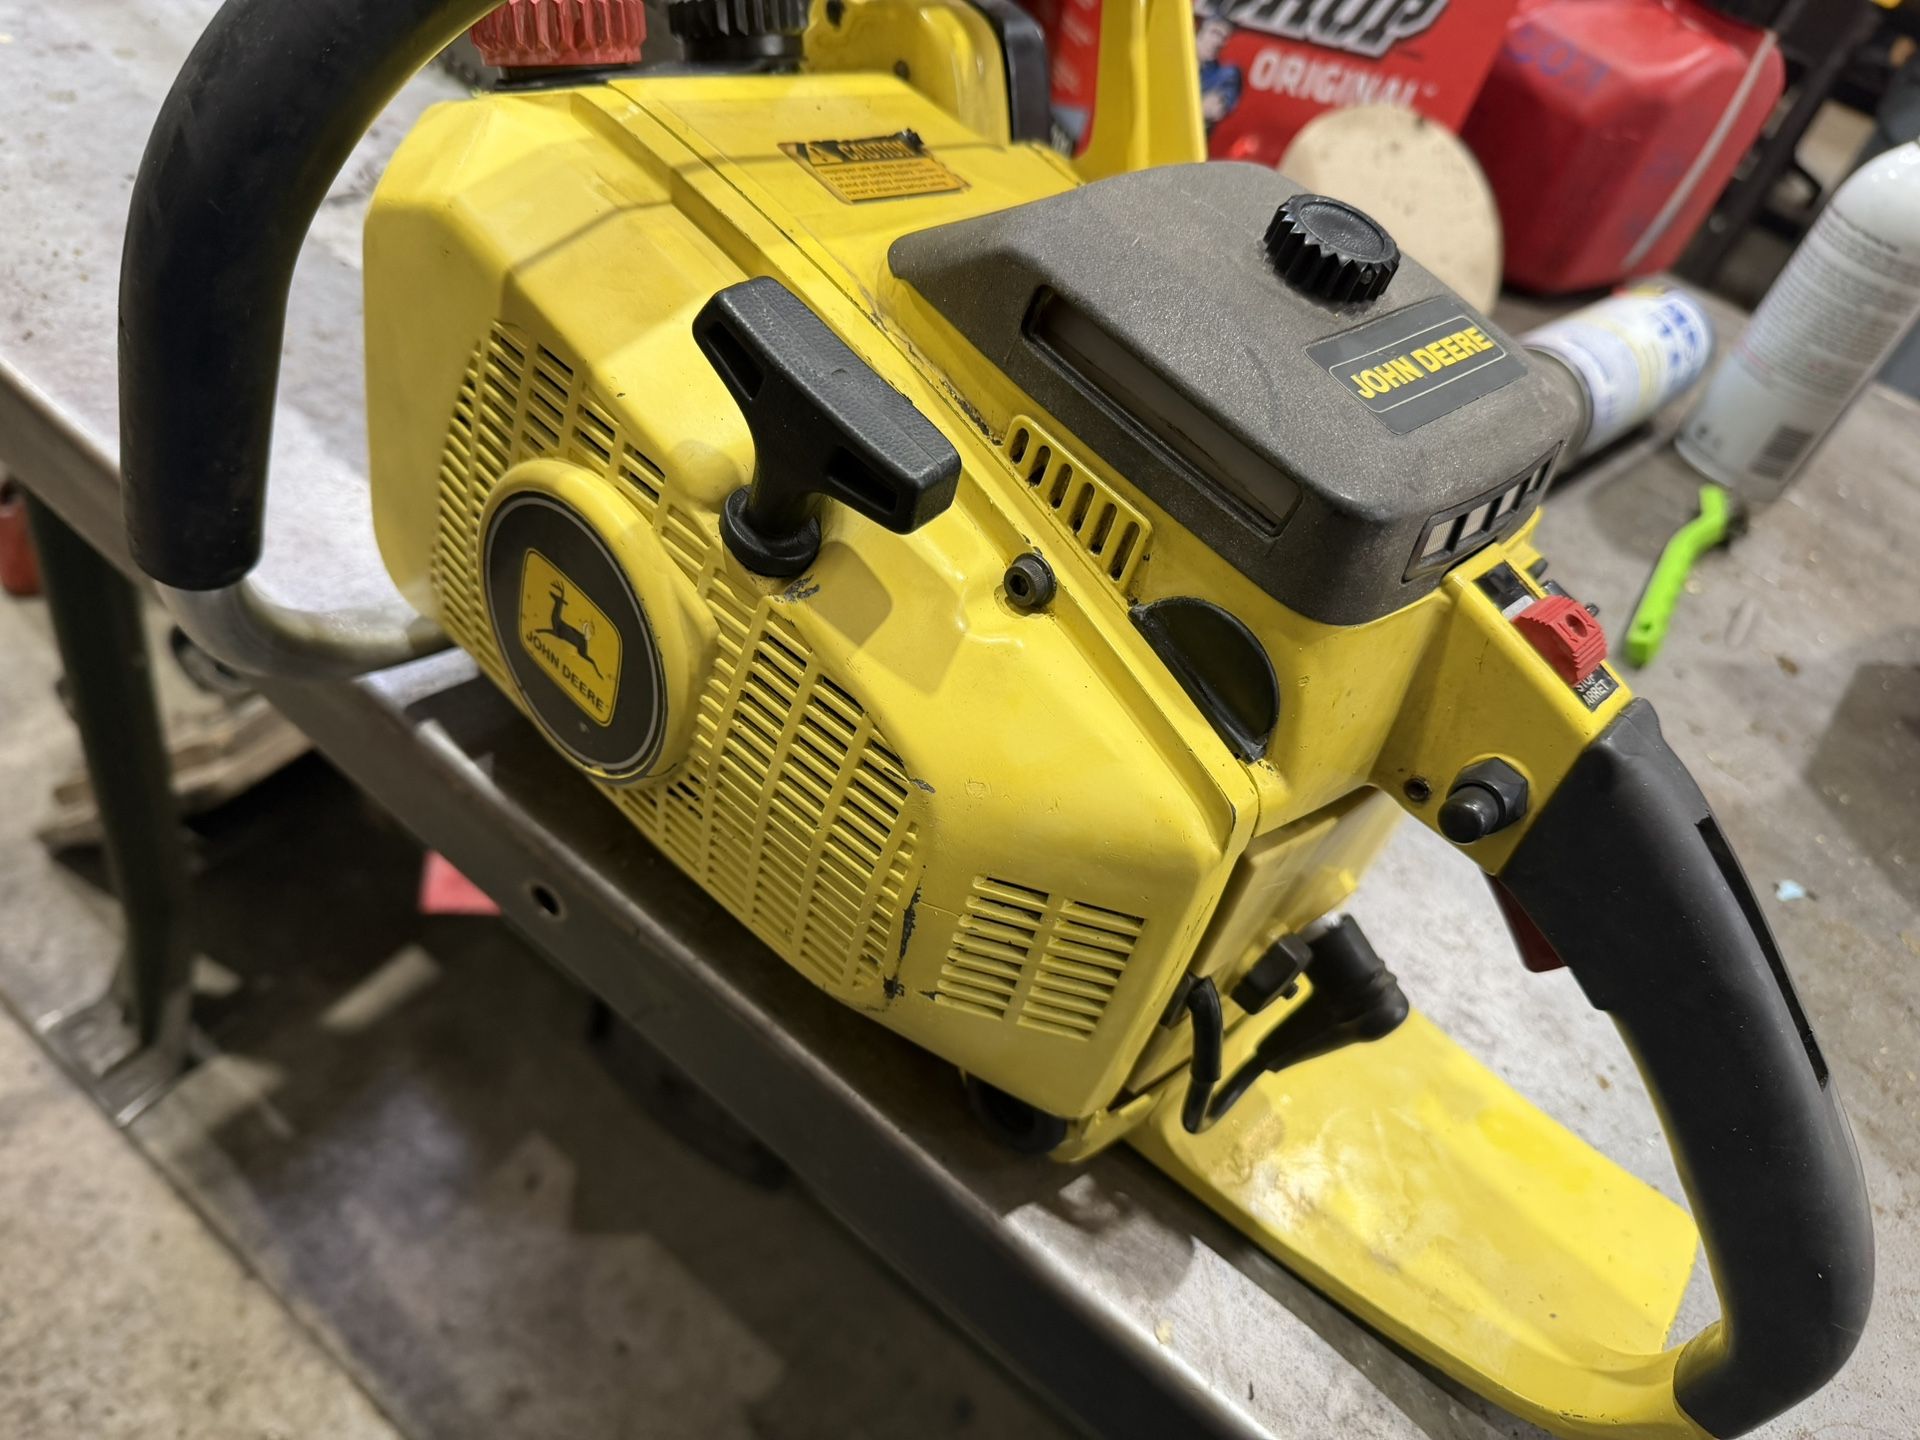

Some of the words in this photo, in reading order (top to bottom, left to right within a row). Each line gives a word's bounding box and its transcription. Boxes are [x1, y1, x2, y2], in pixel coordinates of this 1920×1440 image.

[1249, 48, 1420, 108] ORIGINAL
[838, 140, 915, 161] CAUTION
[1351, 355, 1425, 399] JOHN
[1410, 326, 1494, 374] DEERE
[526, 631, 559, 669] JOHN
[562, 664, 604, 712] DEERE
